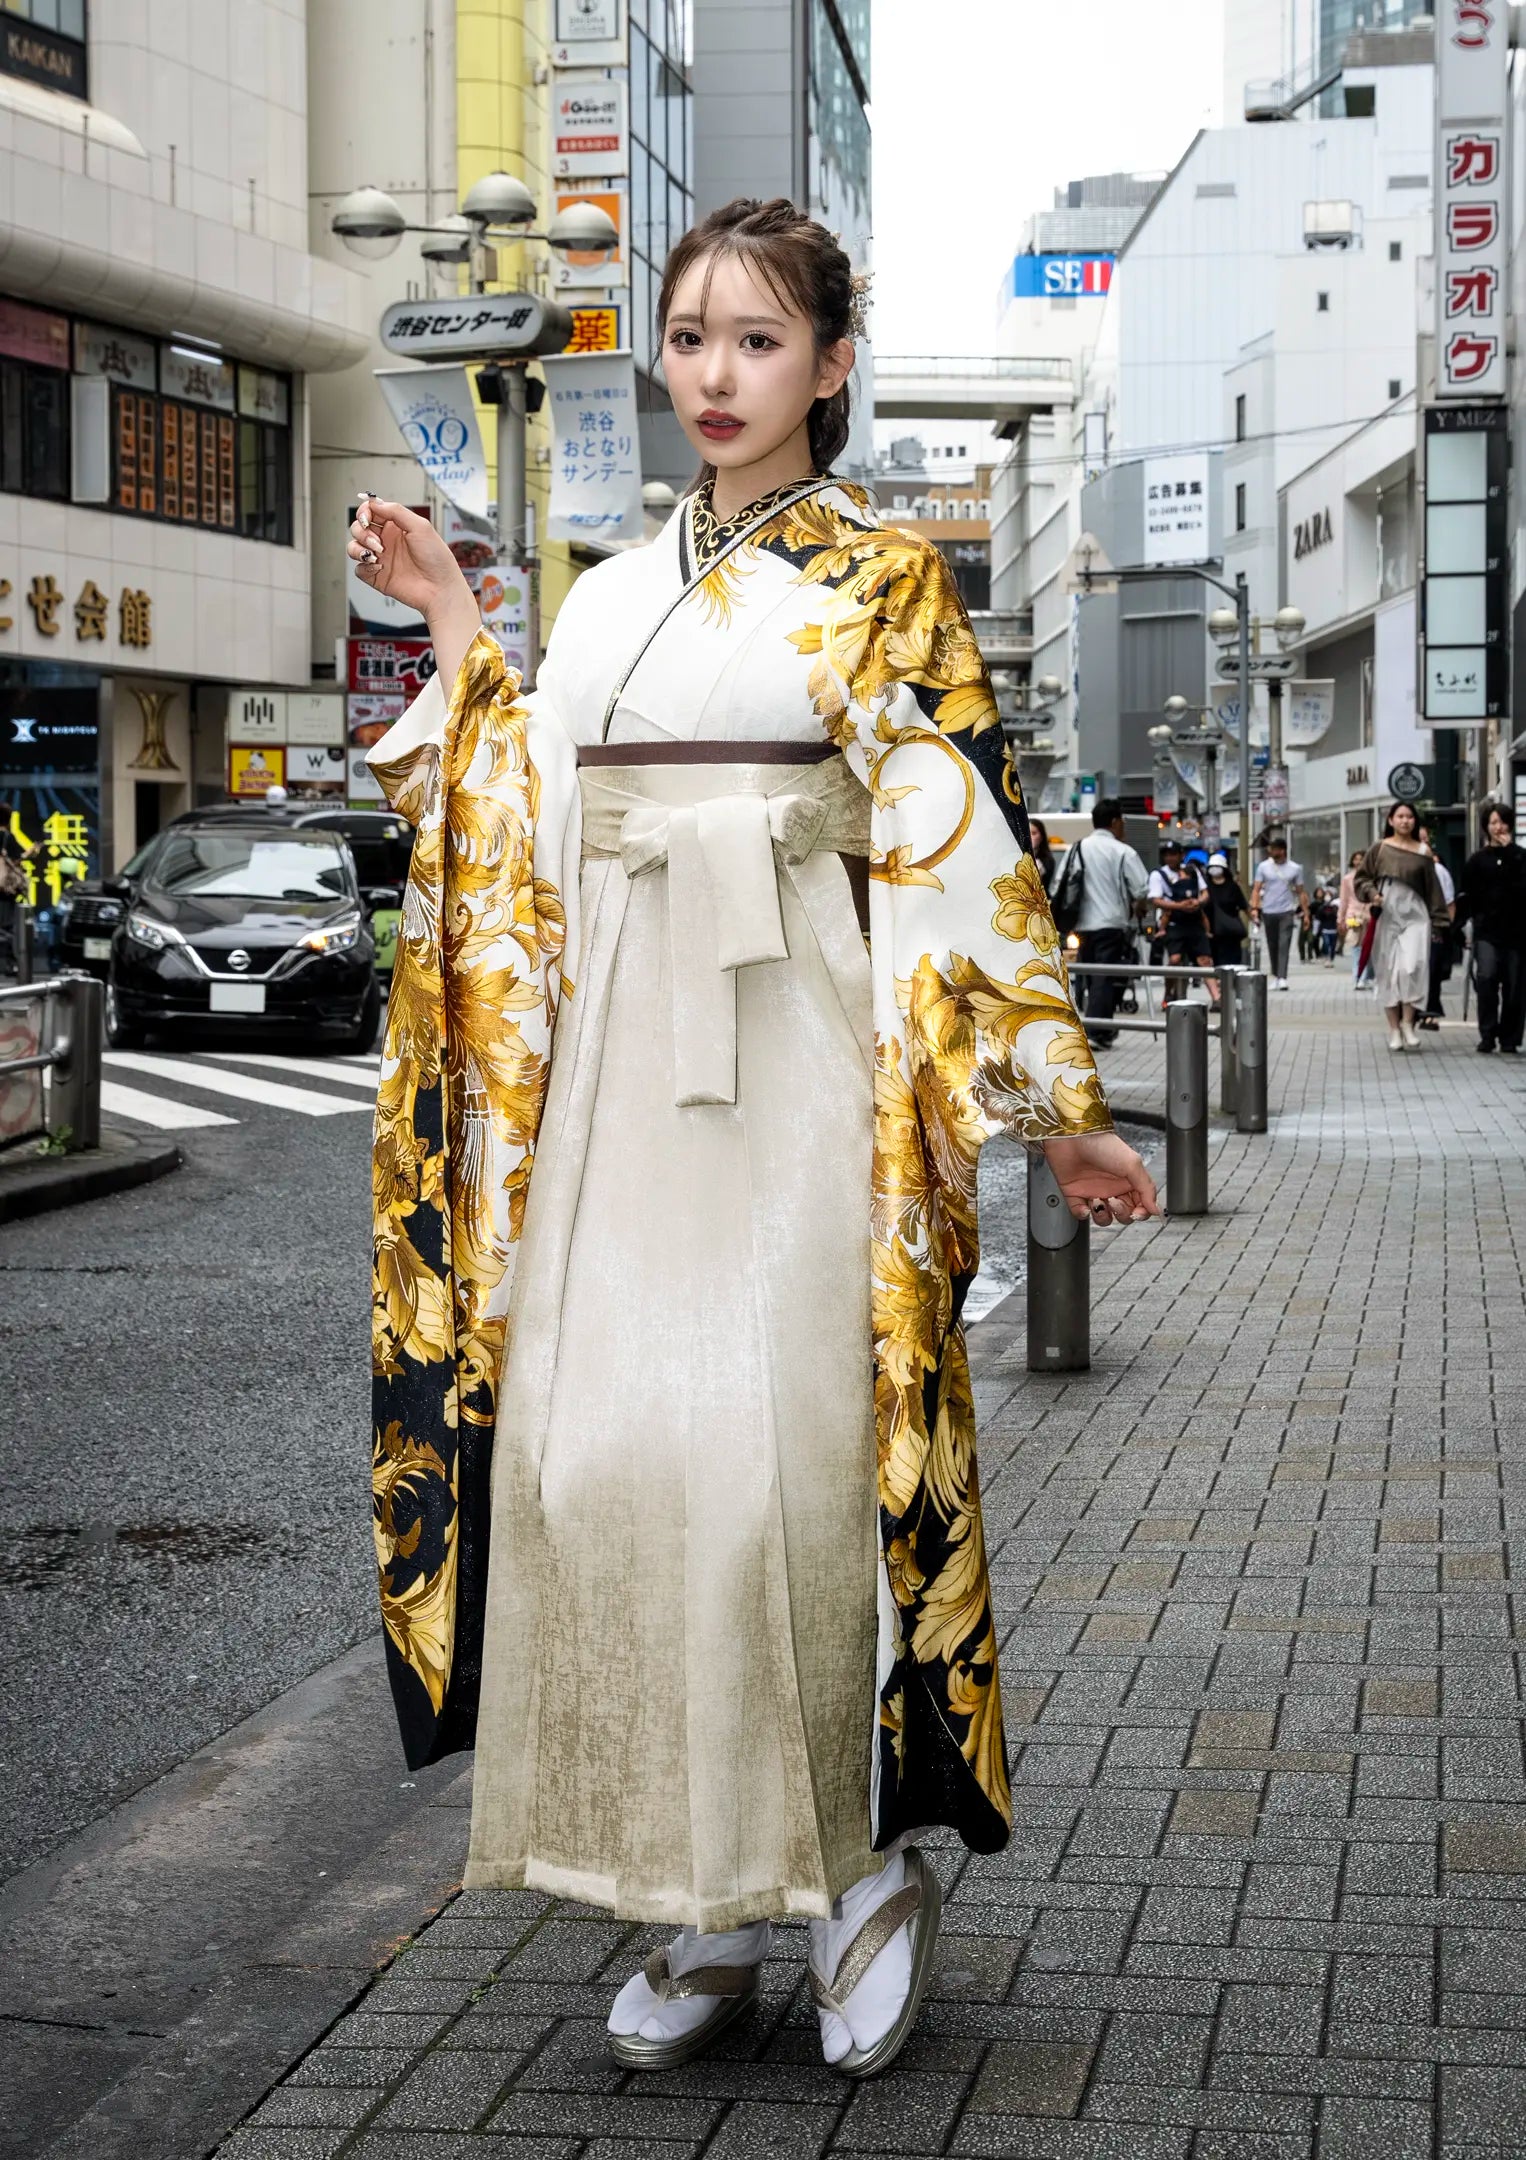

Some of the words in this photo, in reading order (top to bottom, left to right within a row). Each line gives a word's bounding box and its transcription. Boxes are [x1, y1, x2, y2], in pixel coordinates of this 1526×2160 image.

[7, 33, 73, 78] KAIKAN
[558, 48, 569, 61] 4
[559, 160, 569, 173] 3
[1448, 136, 1498, 382] カラオケ
[560, 269, 570, 283] 2
[389, 307, 533, 338] 渋谷センター街
[570, 311, 611, 353] 薬
[578, 411, 615, 432] 渋谷
[563, 436, 632, 457] おとなり
[562, 461, 633, 483] サンデー
[1148, 481, 1202, 500] 広告募集
[1293, 506, 1334, 560] ZARA
[1346, 764, 1369, 786] ZARA
